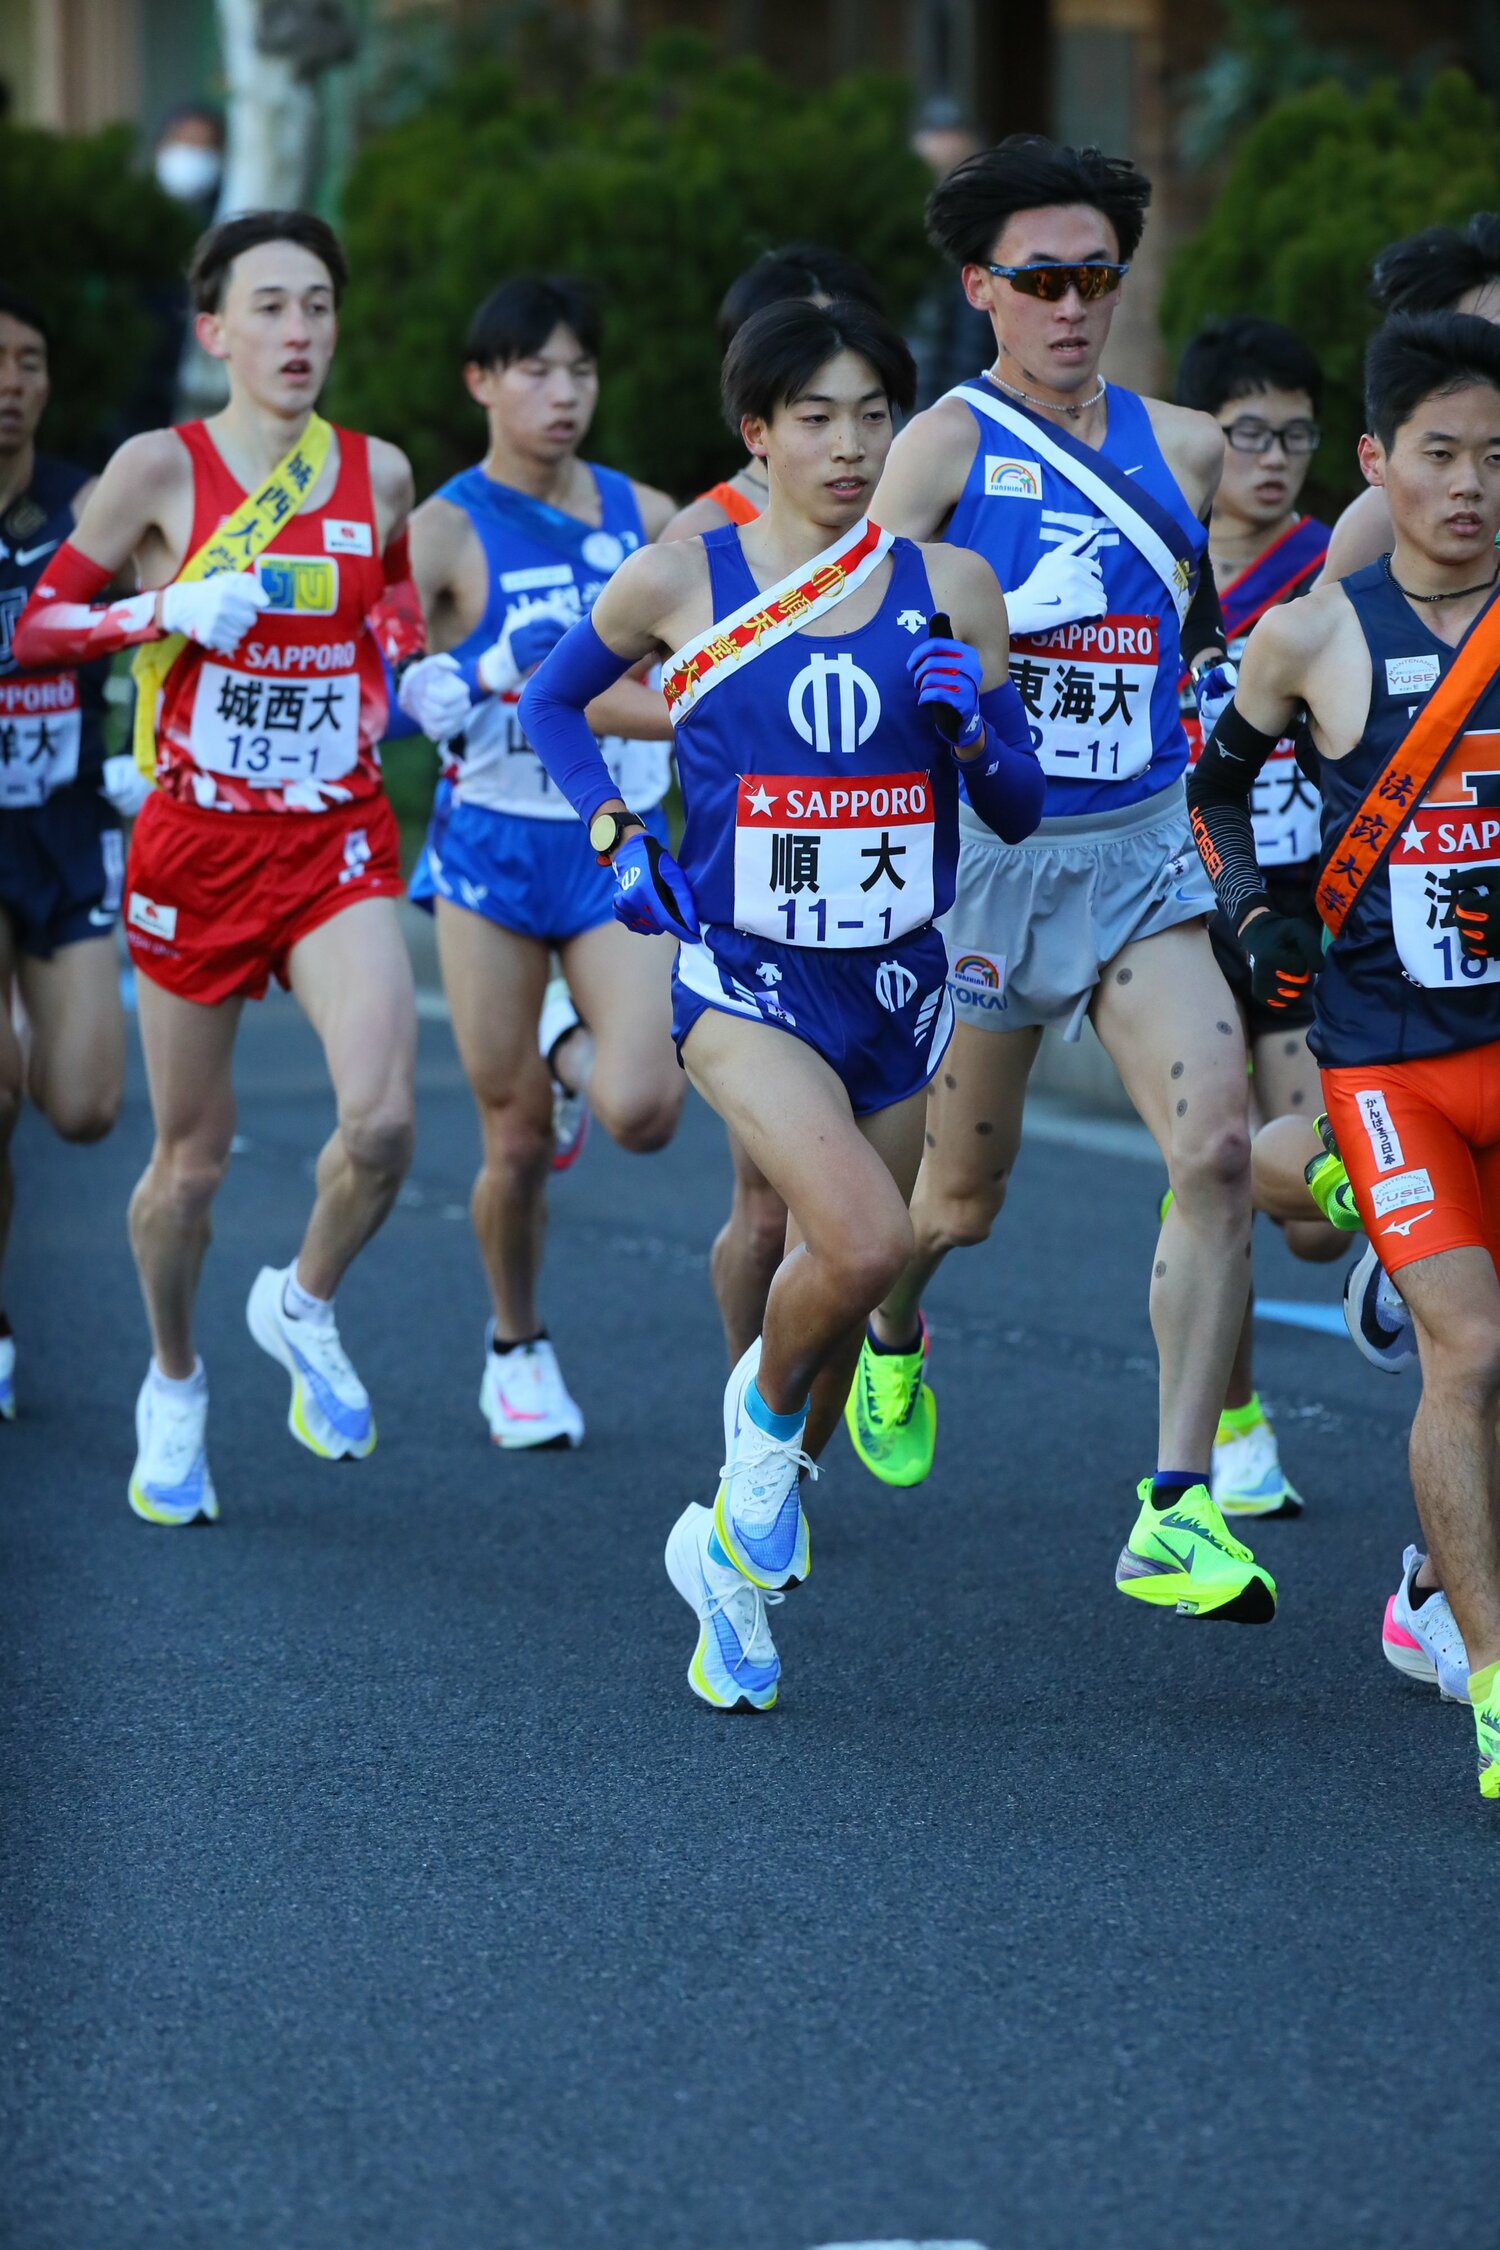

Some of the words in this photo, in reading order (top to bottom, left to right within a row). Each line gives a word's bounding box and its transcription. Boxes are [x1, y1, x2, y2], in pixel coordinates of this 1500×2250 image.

[991, 484, 1023, 493] SUNSHINE
[244, 641, 356, 671] SAPPORO
[217, 674, 344, 733] 城西大
[1008, 659, 1140, 727] 東海大
[227, 733, 320, 773] 13-1
[786, 784, 927, 818] SAPPORO
[1320, 769, 1415, 916] 法政大学
[1438, 820, 1500, 853] SAP
[778, 898, 892, 941] 11-1
[945, 980, 1009, 1011] TOKAI
[1365, 1098, 1396, 1165] がんばろう日本
[1376, 1185, 1432, 1206] YUSEI
